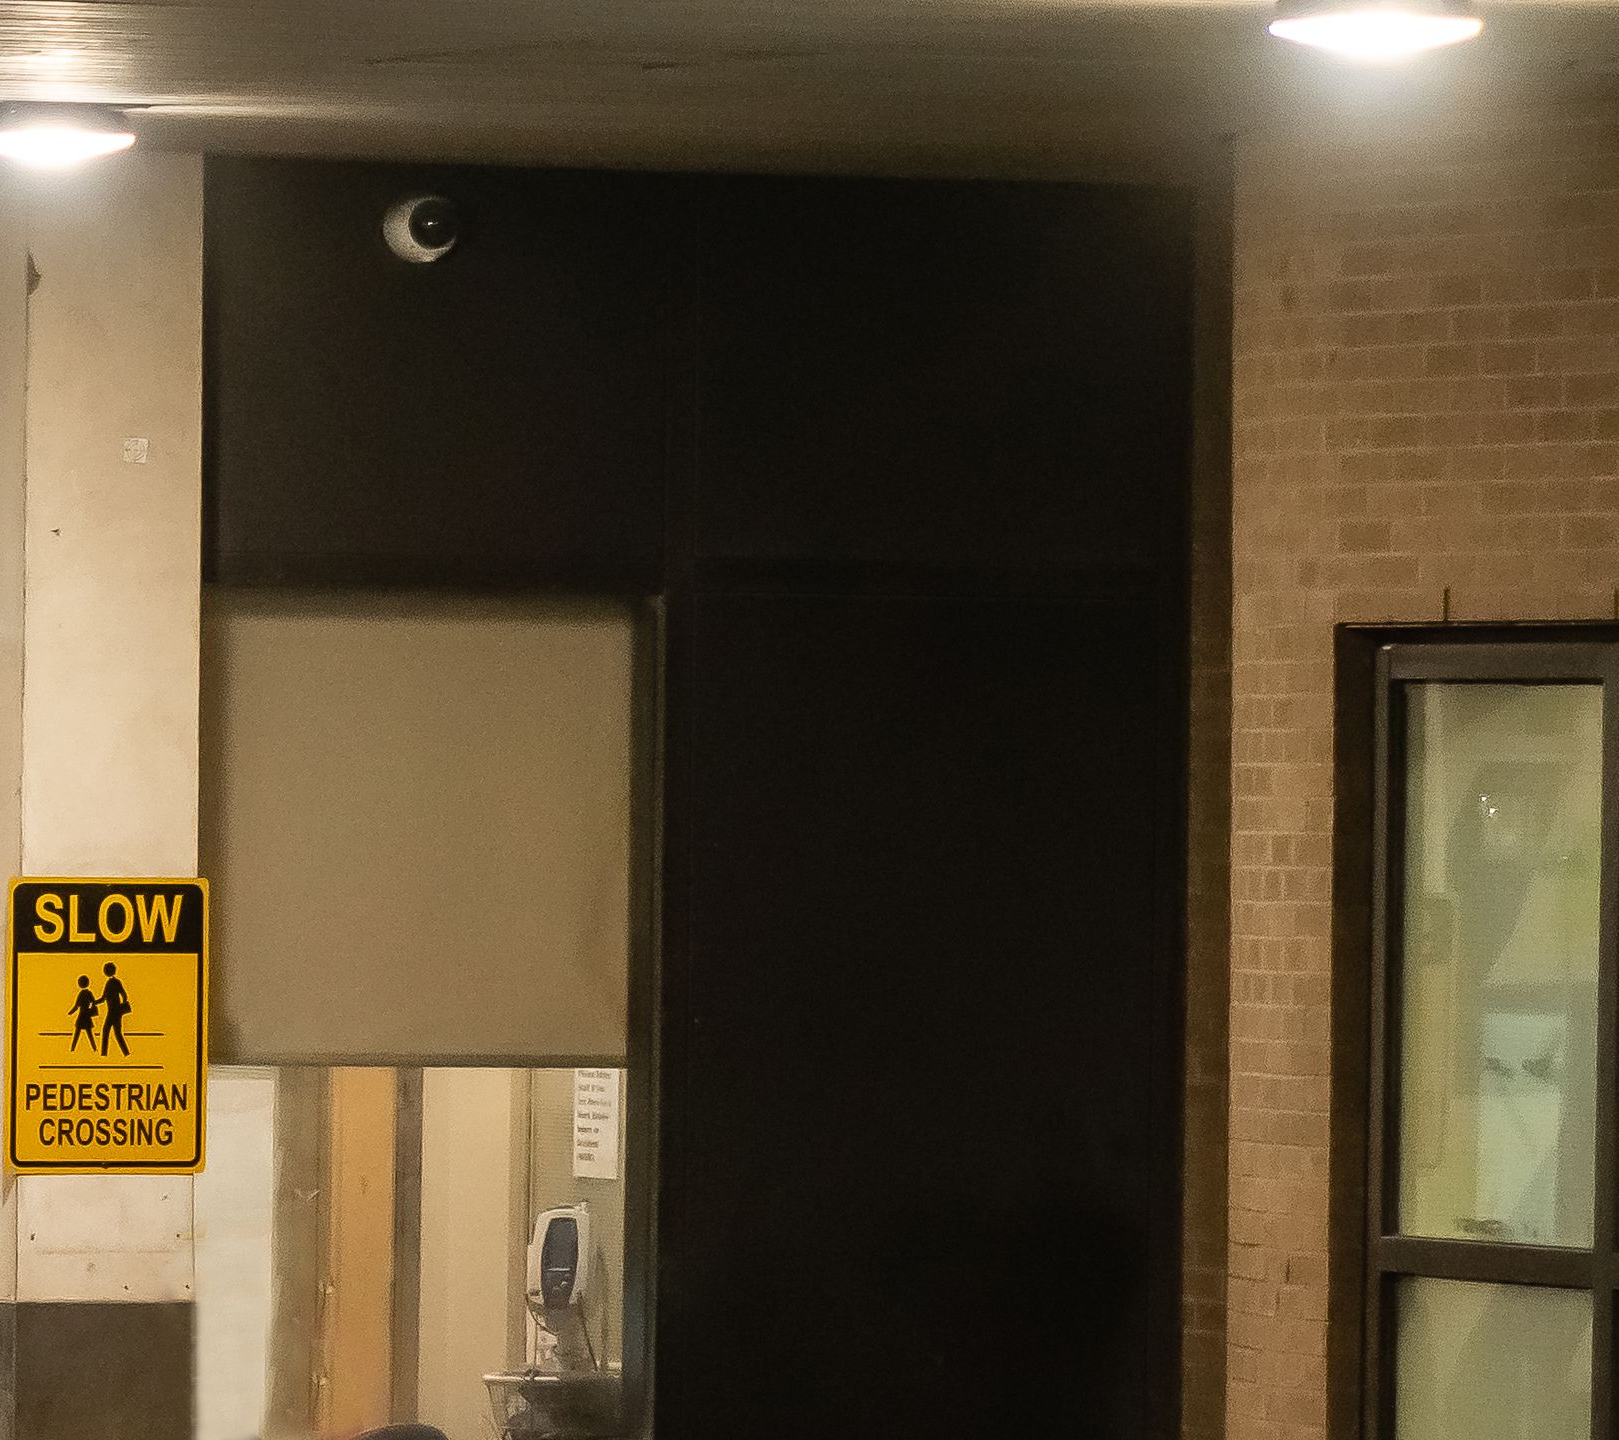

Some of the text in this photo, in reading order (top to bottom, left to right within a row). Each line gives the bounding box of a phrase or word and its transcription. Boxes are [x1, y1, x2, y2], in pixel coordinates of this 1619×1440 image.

[34, 894, 183, 943] SLOW
[25, 1083, 188, 1111] PEDESTRIAN
[39, 1118, 174, 1147] CROSSING
